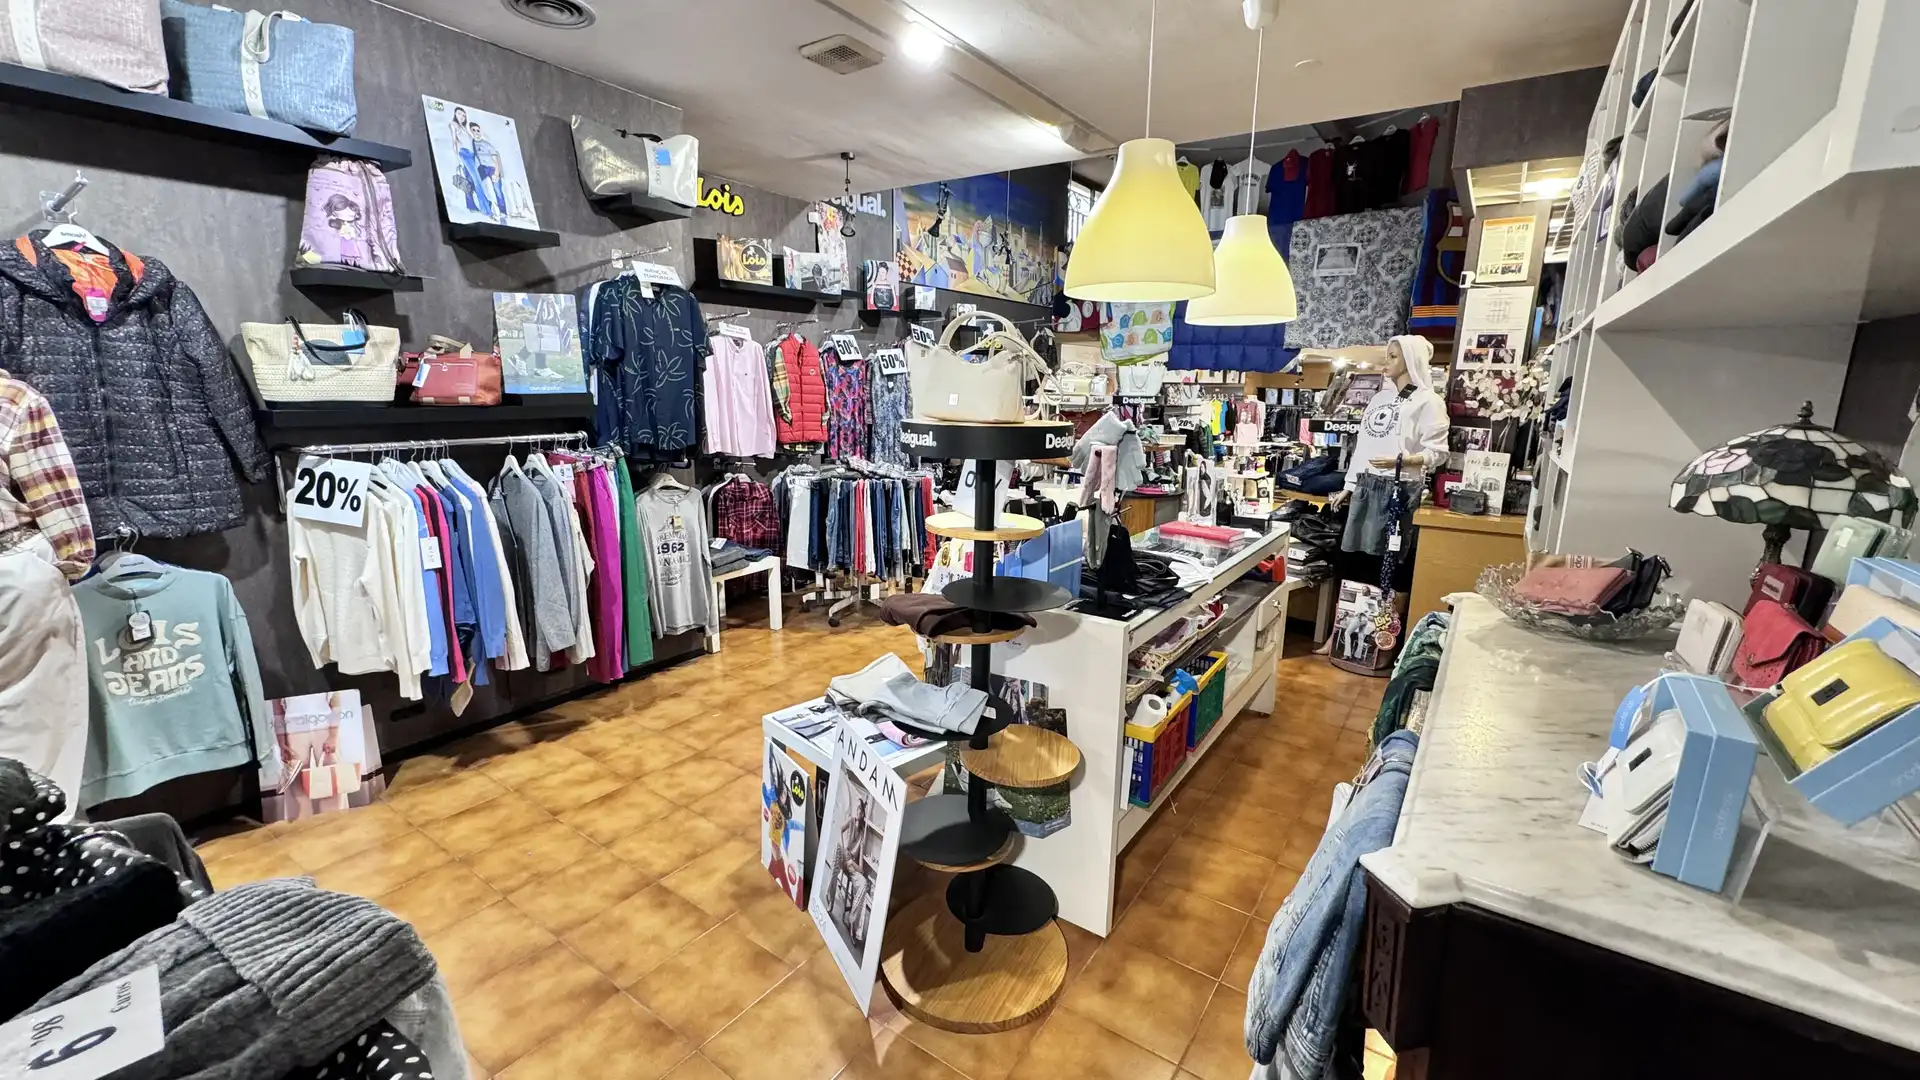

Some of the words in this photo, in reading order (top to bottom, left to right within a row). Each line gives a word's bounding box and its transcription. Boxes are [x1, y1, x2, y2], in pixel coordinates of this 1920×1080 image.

[697, 176, 745, 216] Lois
[742, 252, 766, 267] Lois
[835, 337, 860, 356] 50%
[913, 327, 937, 347] 50%
[881, 354, 906, 370] 50%
[1178, 419, 1195, 429] 20%
[294, 467, 362, 513] 20%
[657, 542, 686, 555] 1962
[94, 619, 203, 666] LIS
[836, 727, 899, 812] ANDAM
[108, 980, 132, 1014] Euros
[27, 1025, 118, 1070] 6
